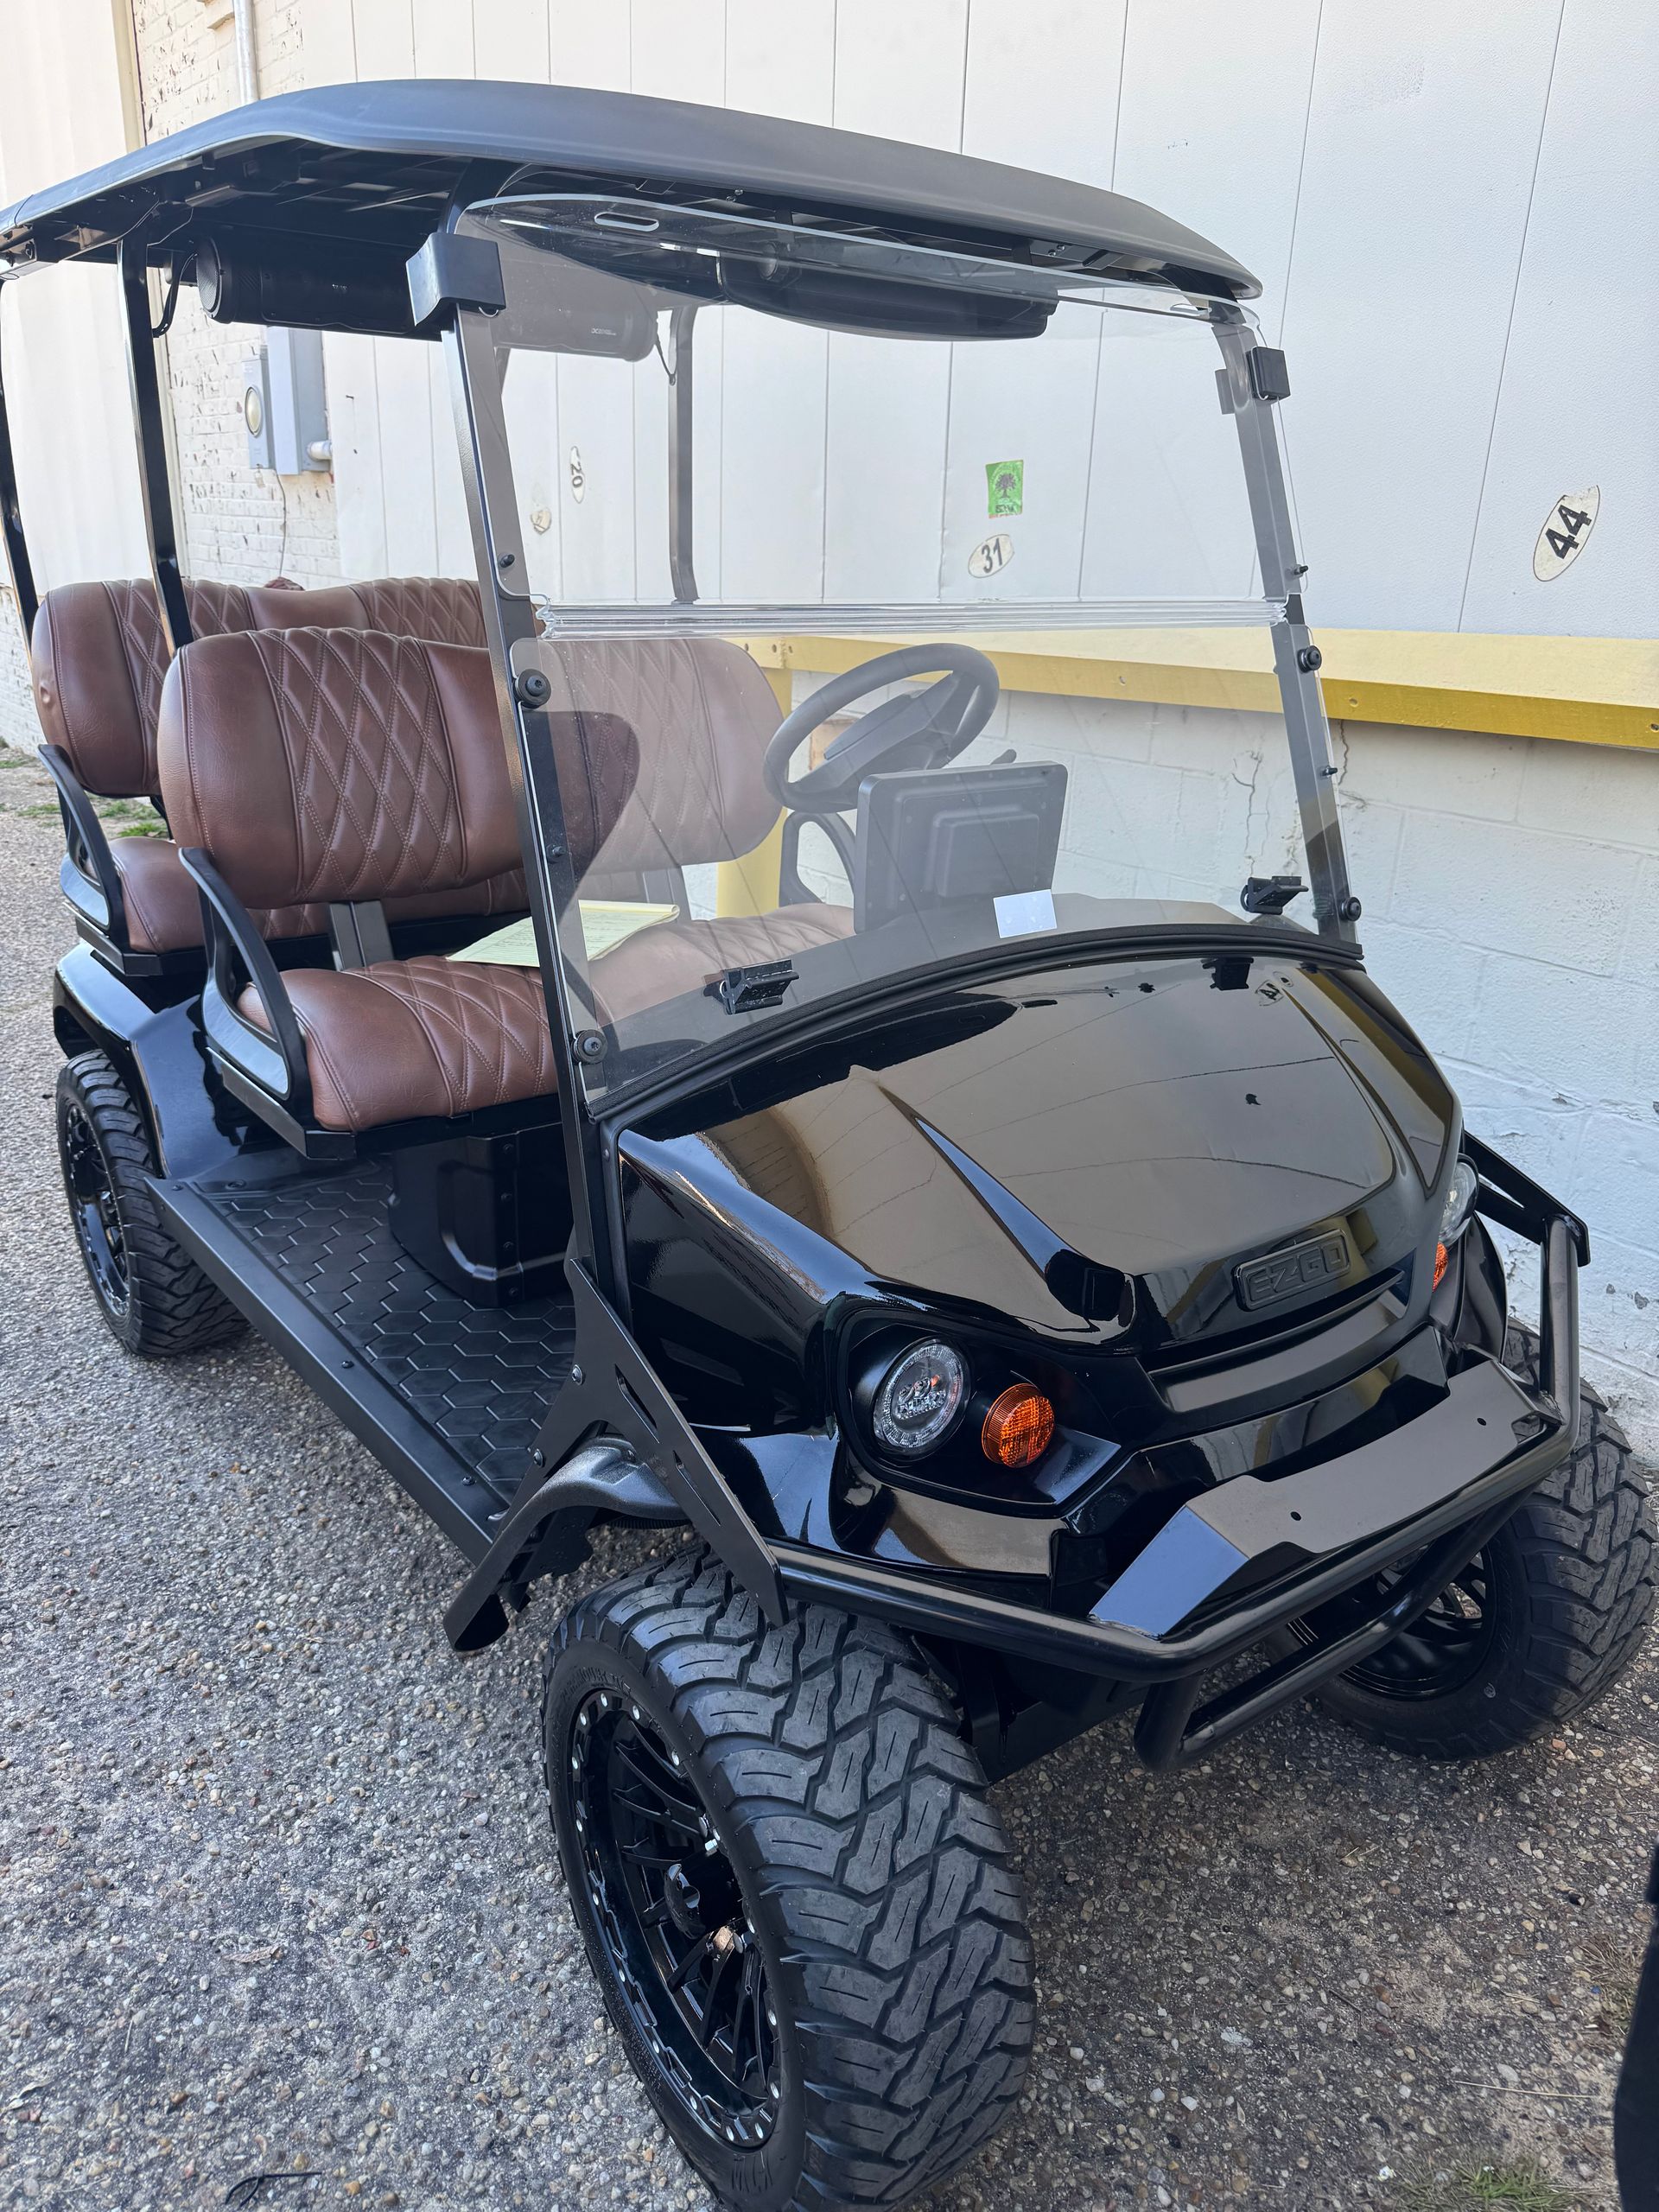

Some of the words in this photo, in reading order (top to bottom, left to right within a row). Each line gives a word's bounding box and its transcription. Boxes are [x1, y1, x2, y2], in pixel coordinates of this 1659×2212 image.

[570, 461, 584, 488] 20
[1545, 505, 1592, 559] 44
[981, 537, 1003, 574] 31
[1247, 1237, 1348, 1301] EZGO
